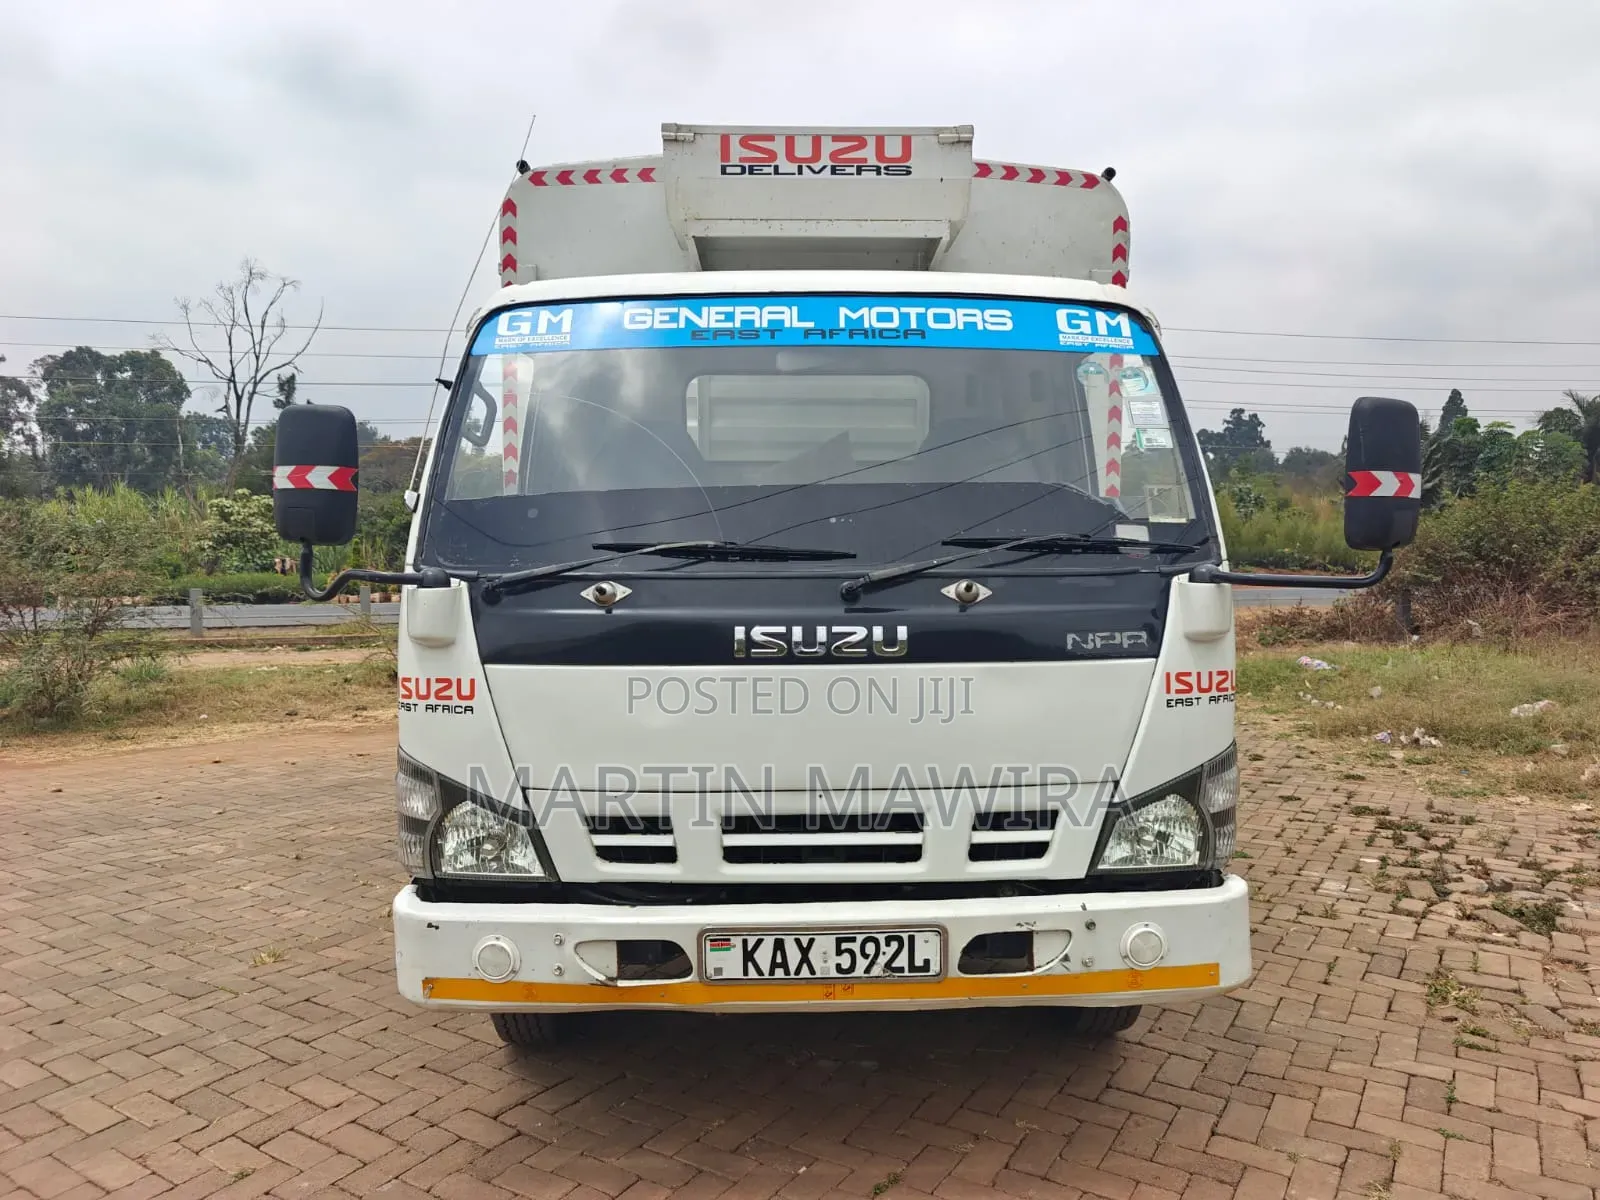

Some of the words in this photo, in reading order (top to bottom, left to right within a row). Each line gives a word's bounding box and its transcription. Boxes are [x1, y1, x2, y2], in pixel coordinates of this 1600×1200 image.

[720, 134, 912, 164] ISUZU
[720, 164, 912, 176] DELIVERS
[497, 308, 573, 335] GM
[623, 306, 814, 329] GENERAL
[838, 306, 1013, 331] MOTORS
[1055, 308, 1132, 336] GM
[691, 329, 783, 340] EAST
[803, 328, 926, 340] AFRICA
[734, 626, 908, 657] ISUZU
[1066, 631, 1148, 650] NPR
[400, 677, 476, 701] SUZU
[425, 704, 474, 715] AFRICA
[1166, 697, 1202, 708] EAST
[742, 937, 816, 976] KAX
[834, 934, 931, 975] 592L
